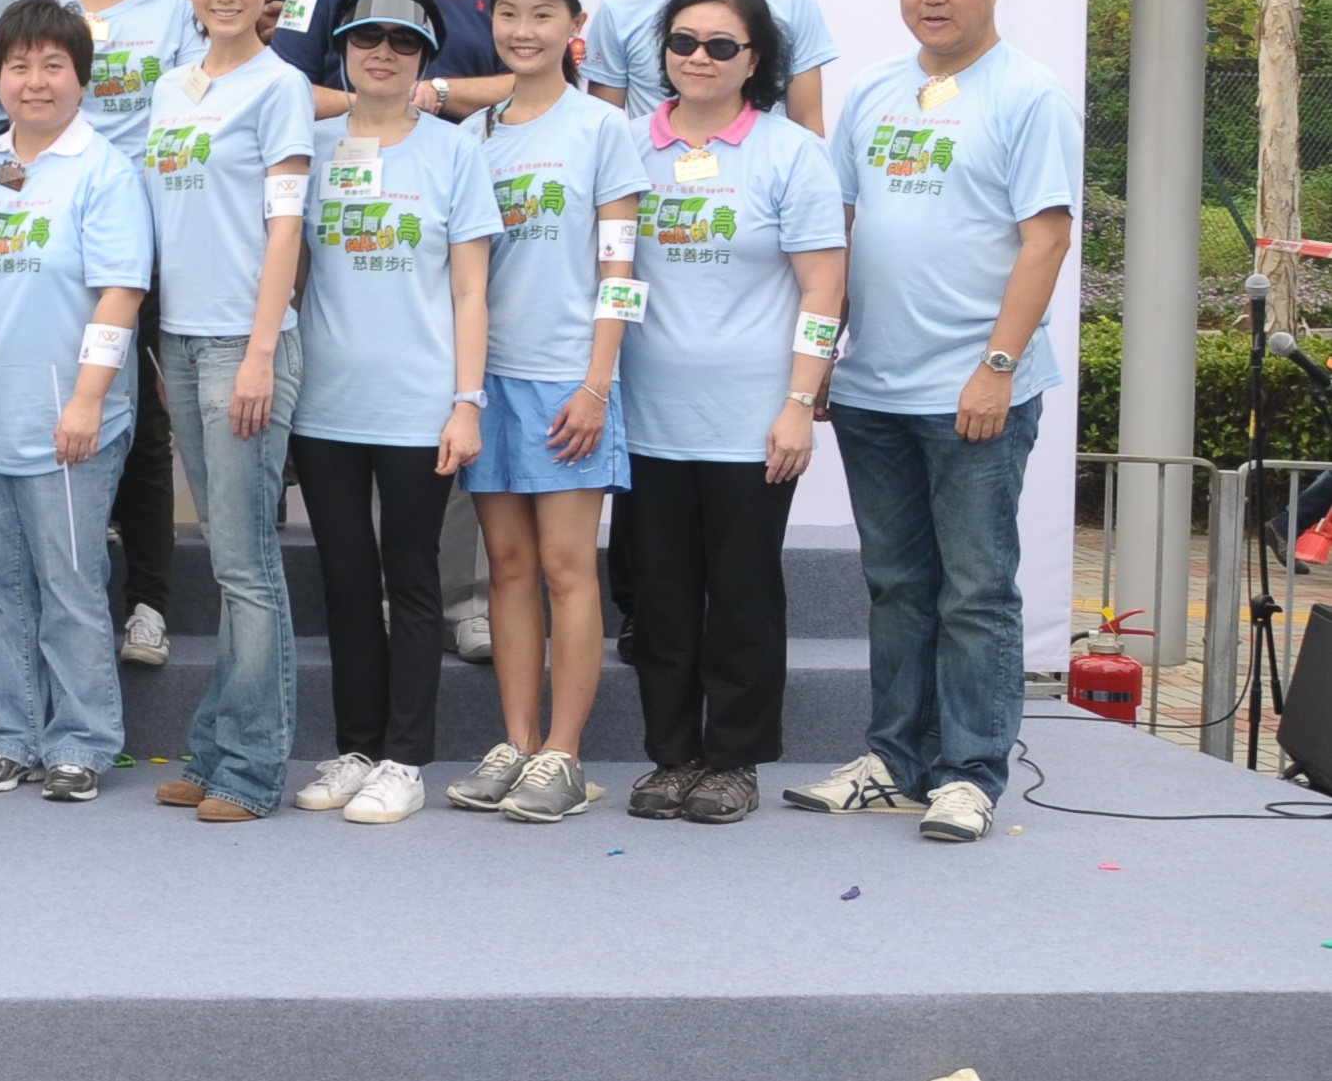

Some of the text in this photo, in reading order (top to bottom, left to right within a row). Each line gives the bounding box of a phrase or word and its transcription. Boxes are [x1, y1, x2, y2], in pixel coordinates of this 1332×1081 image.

[190, 131, 213, 165] 高
[930, 136, 957, 174] 高
[539, 179, 566, 217] 高
[889, 177, 944, 196] 慈善步行
[27, 216, 51, 248] 高
[396, 212, 423, 249] 高
[709, 204, 738, 242] 高
[352, 254, 414, 274] 慈善步行
[666, 247, 731, 265] 慈善步行
